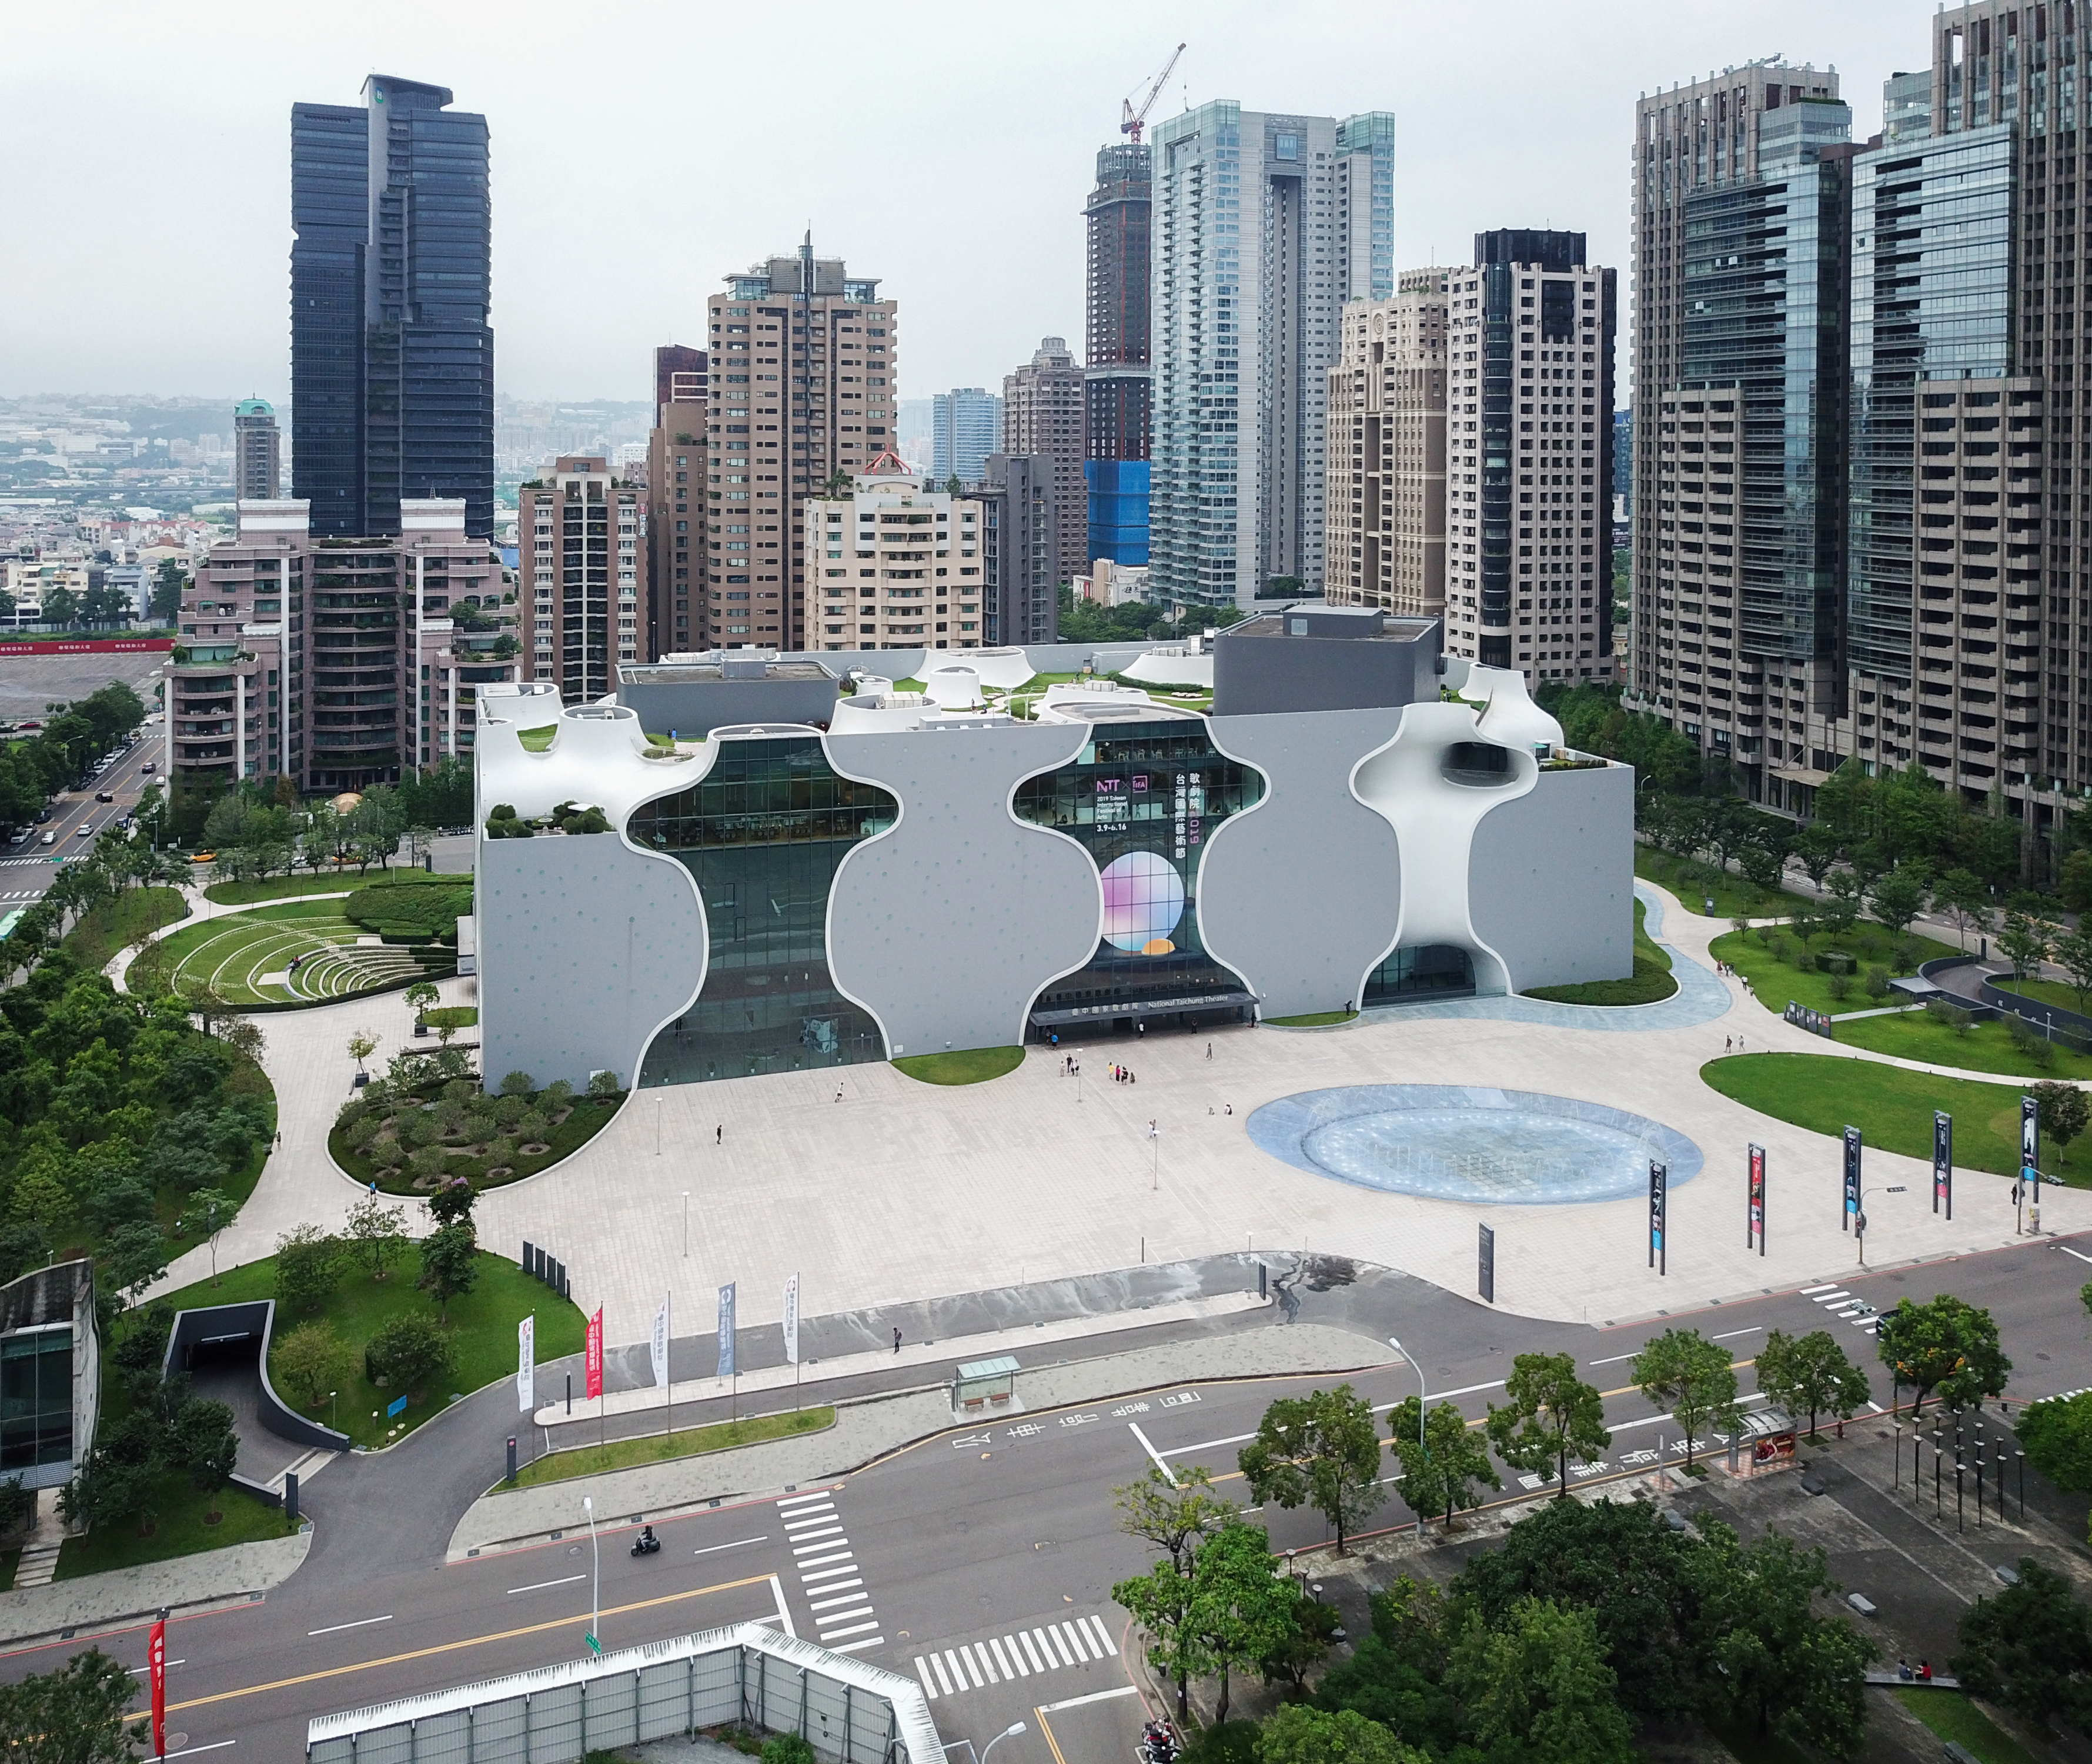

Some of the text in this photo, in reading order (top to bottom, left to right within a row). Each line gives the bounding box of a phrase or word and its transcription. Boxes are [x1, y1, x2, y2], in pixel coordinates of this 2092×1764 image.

[1097, 779, 1120, 793] NTT
[1097, 823, 1127, 832] 3.9-6.16
[1148, 994, 1229, 1008] National Taichung Theater
